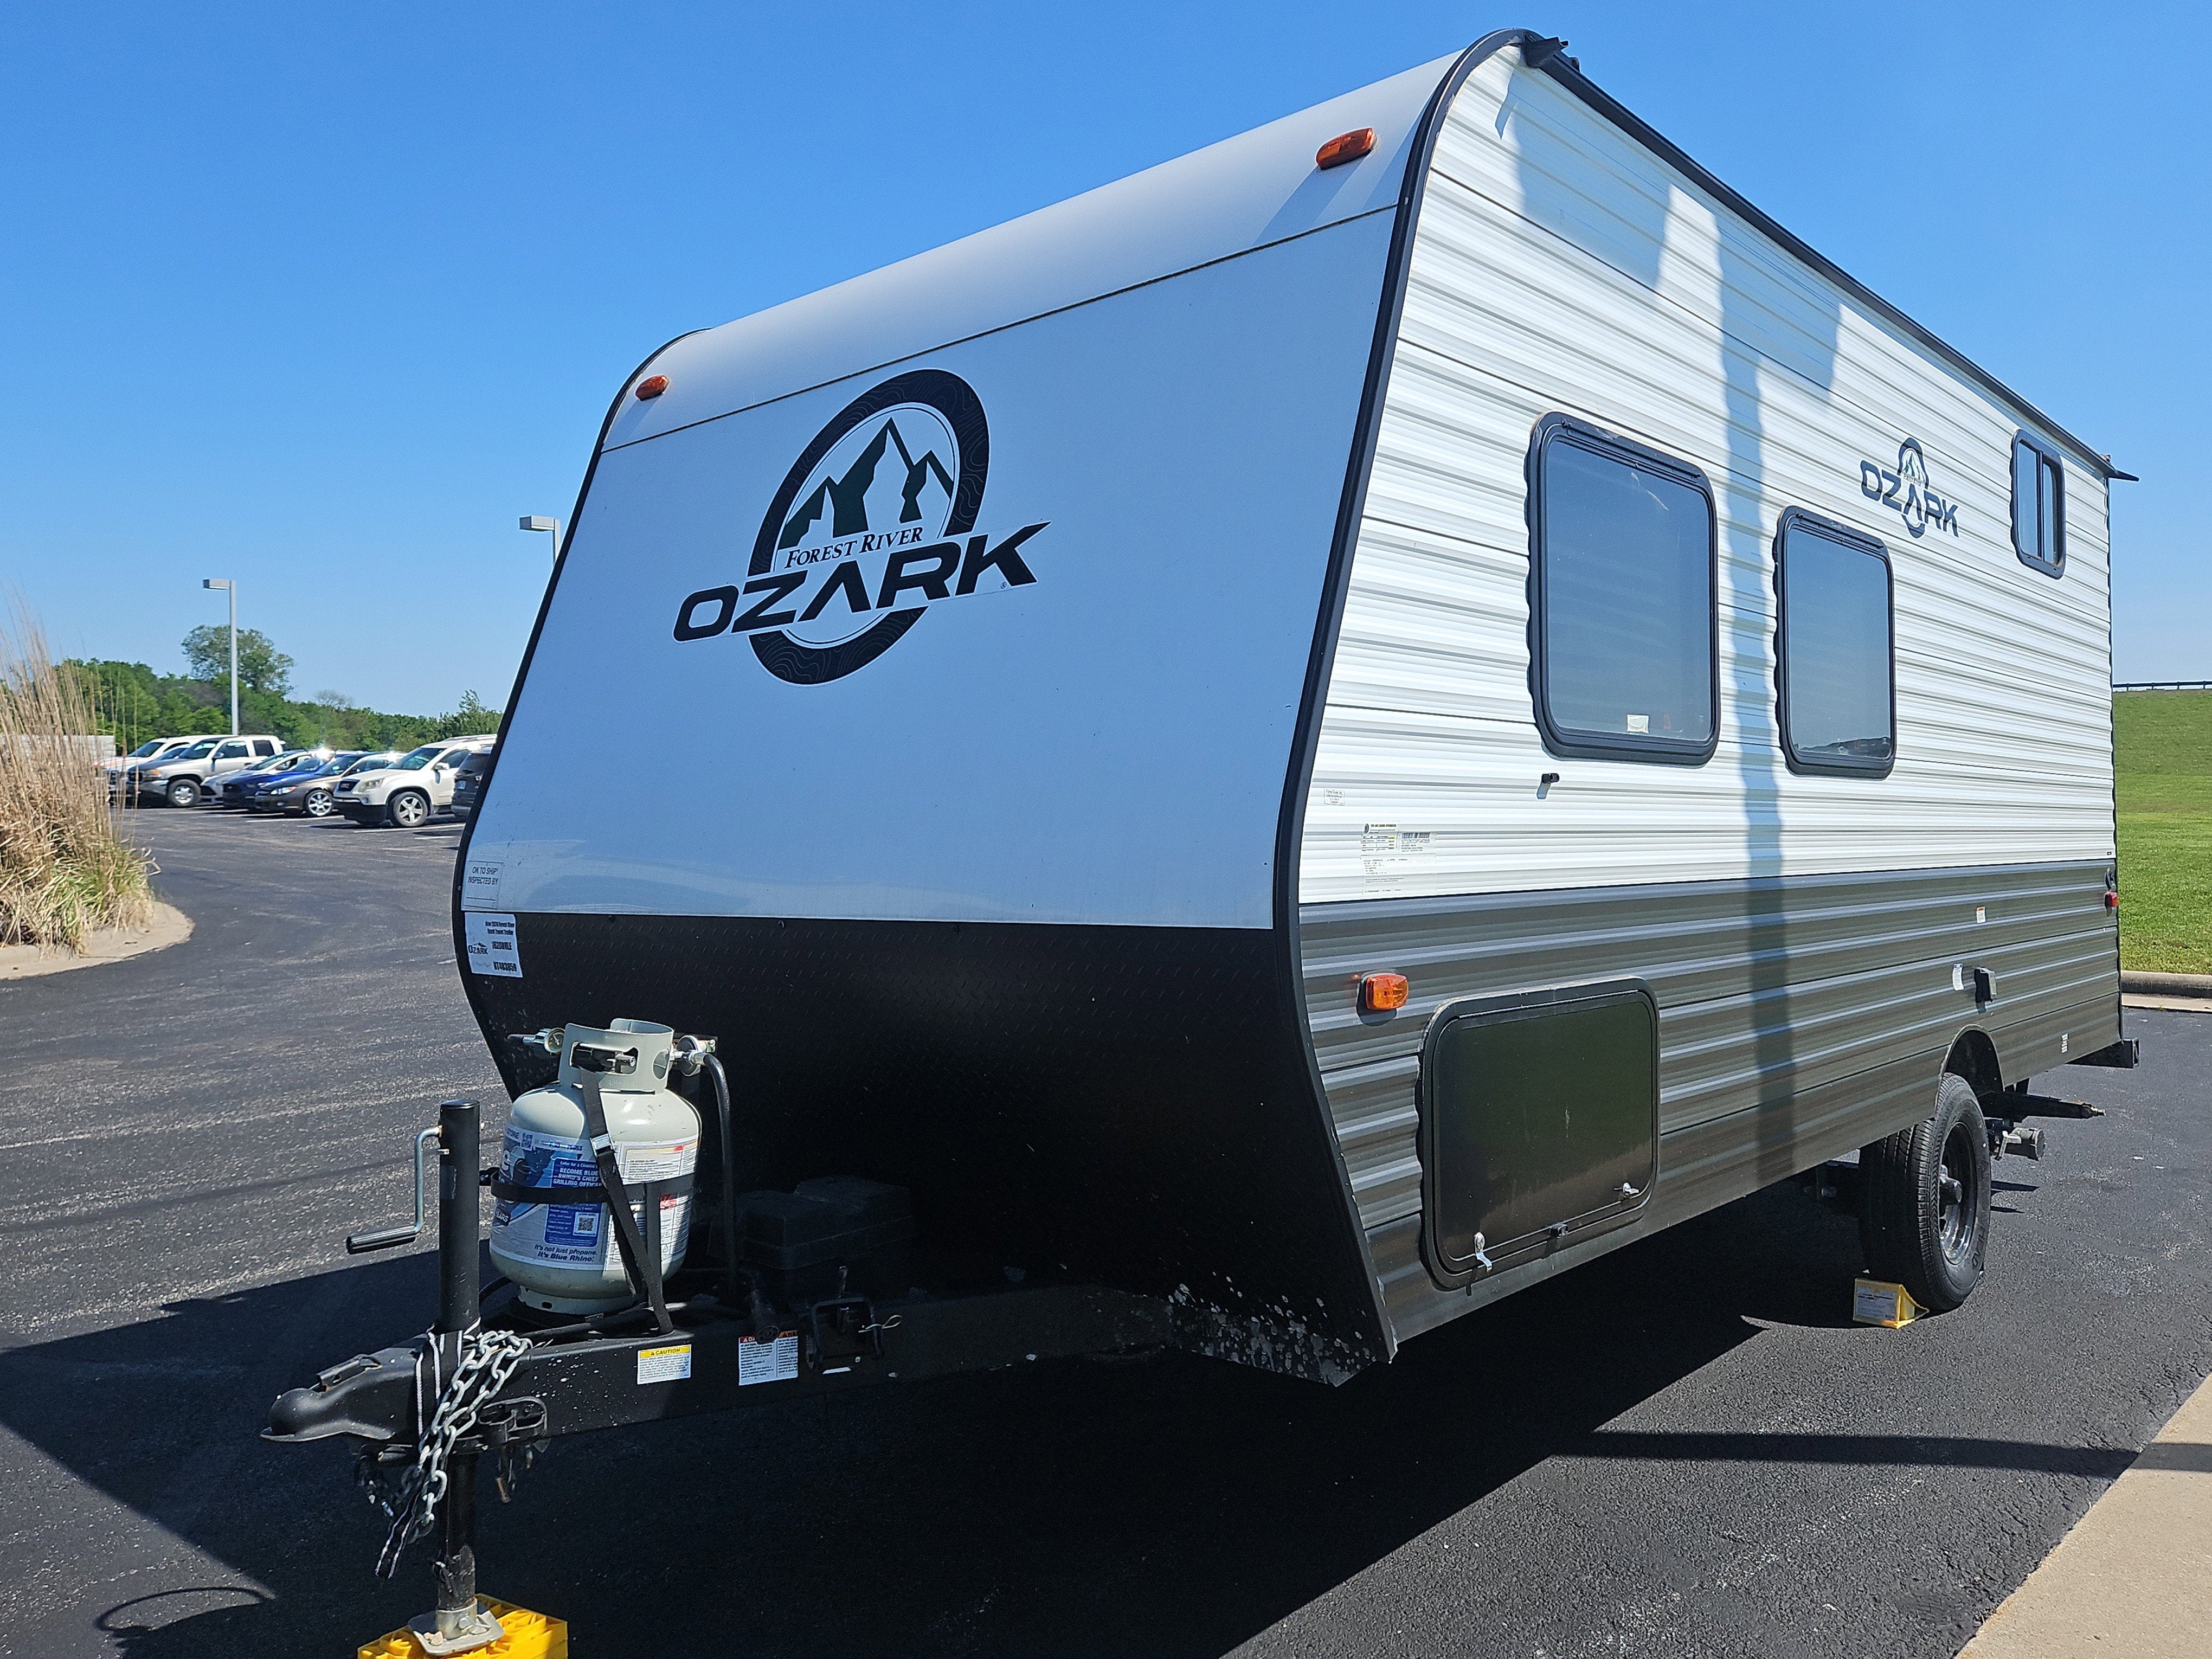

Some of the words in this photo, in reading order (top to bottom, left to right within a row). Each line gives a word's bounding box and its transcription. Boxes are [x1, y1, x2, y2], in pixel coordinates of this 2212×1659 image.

[1860, 460, 1959, 538] OZARK
[674, 522, 1051, 641] OZARK
[468, 876, 491, 885] INSPECTED
